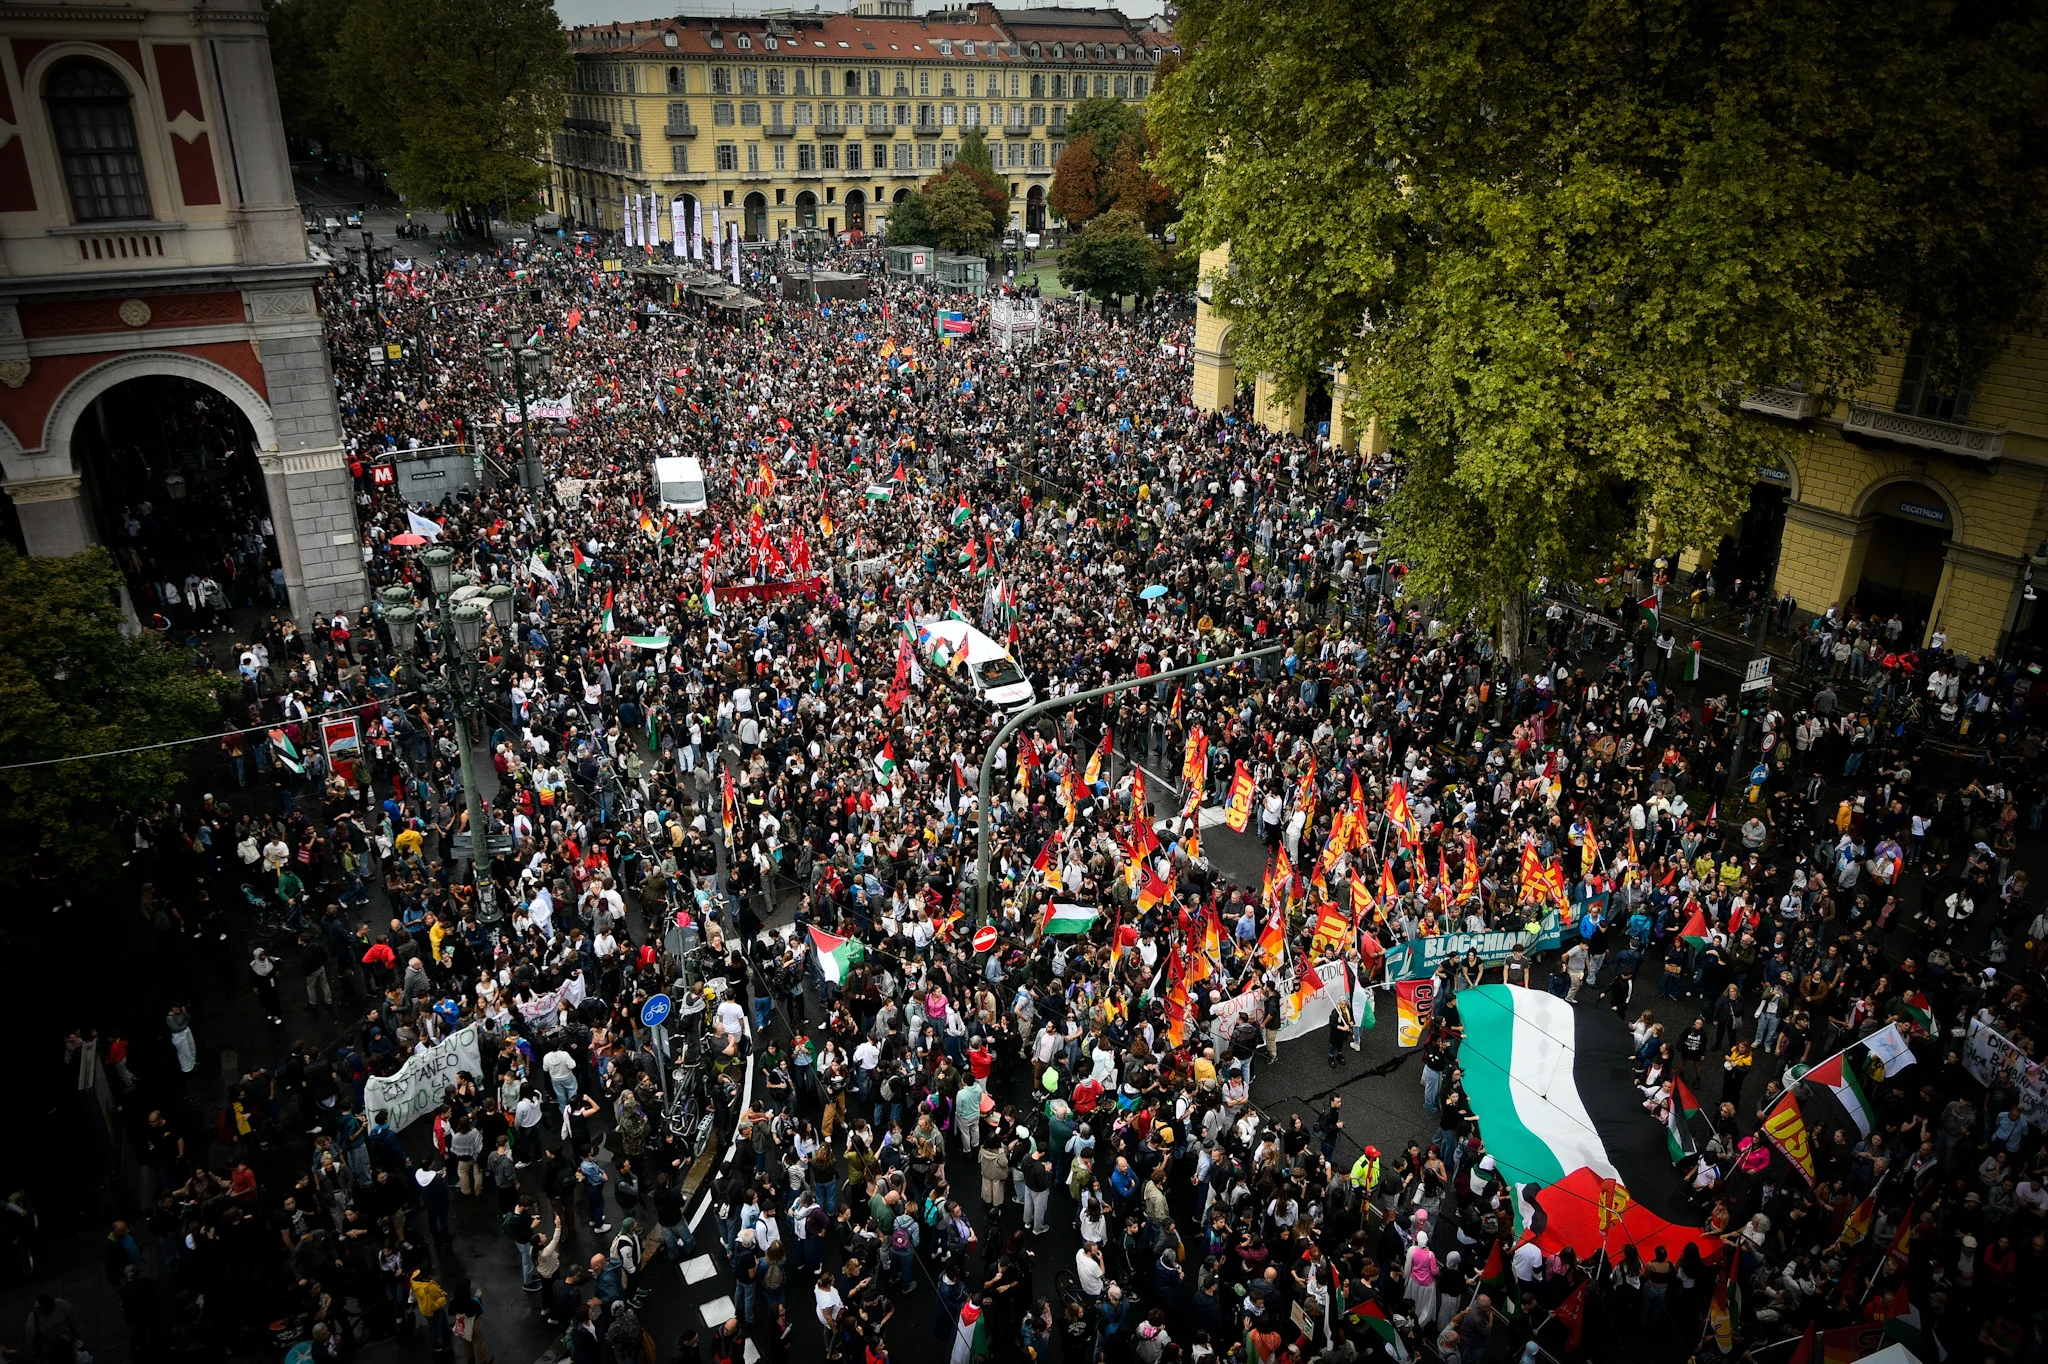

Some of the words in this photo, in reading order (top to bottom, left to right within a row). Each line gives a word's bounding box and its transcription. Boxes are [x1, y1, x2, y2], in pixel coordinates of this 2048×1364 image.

[374, 468, 392, 483] M
[1900, 502, 1944, 521] DECATHLON
[1228, 776, 1252, 827] USB
[1425, 931, 1536, 958] BLOCCHIAM
[382, 1053, 458, 1102] CATTANEO
